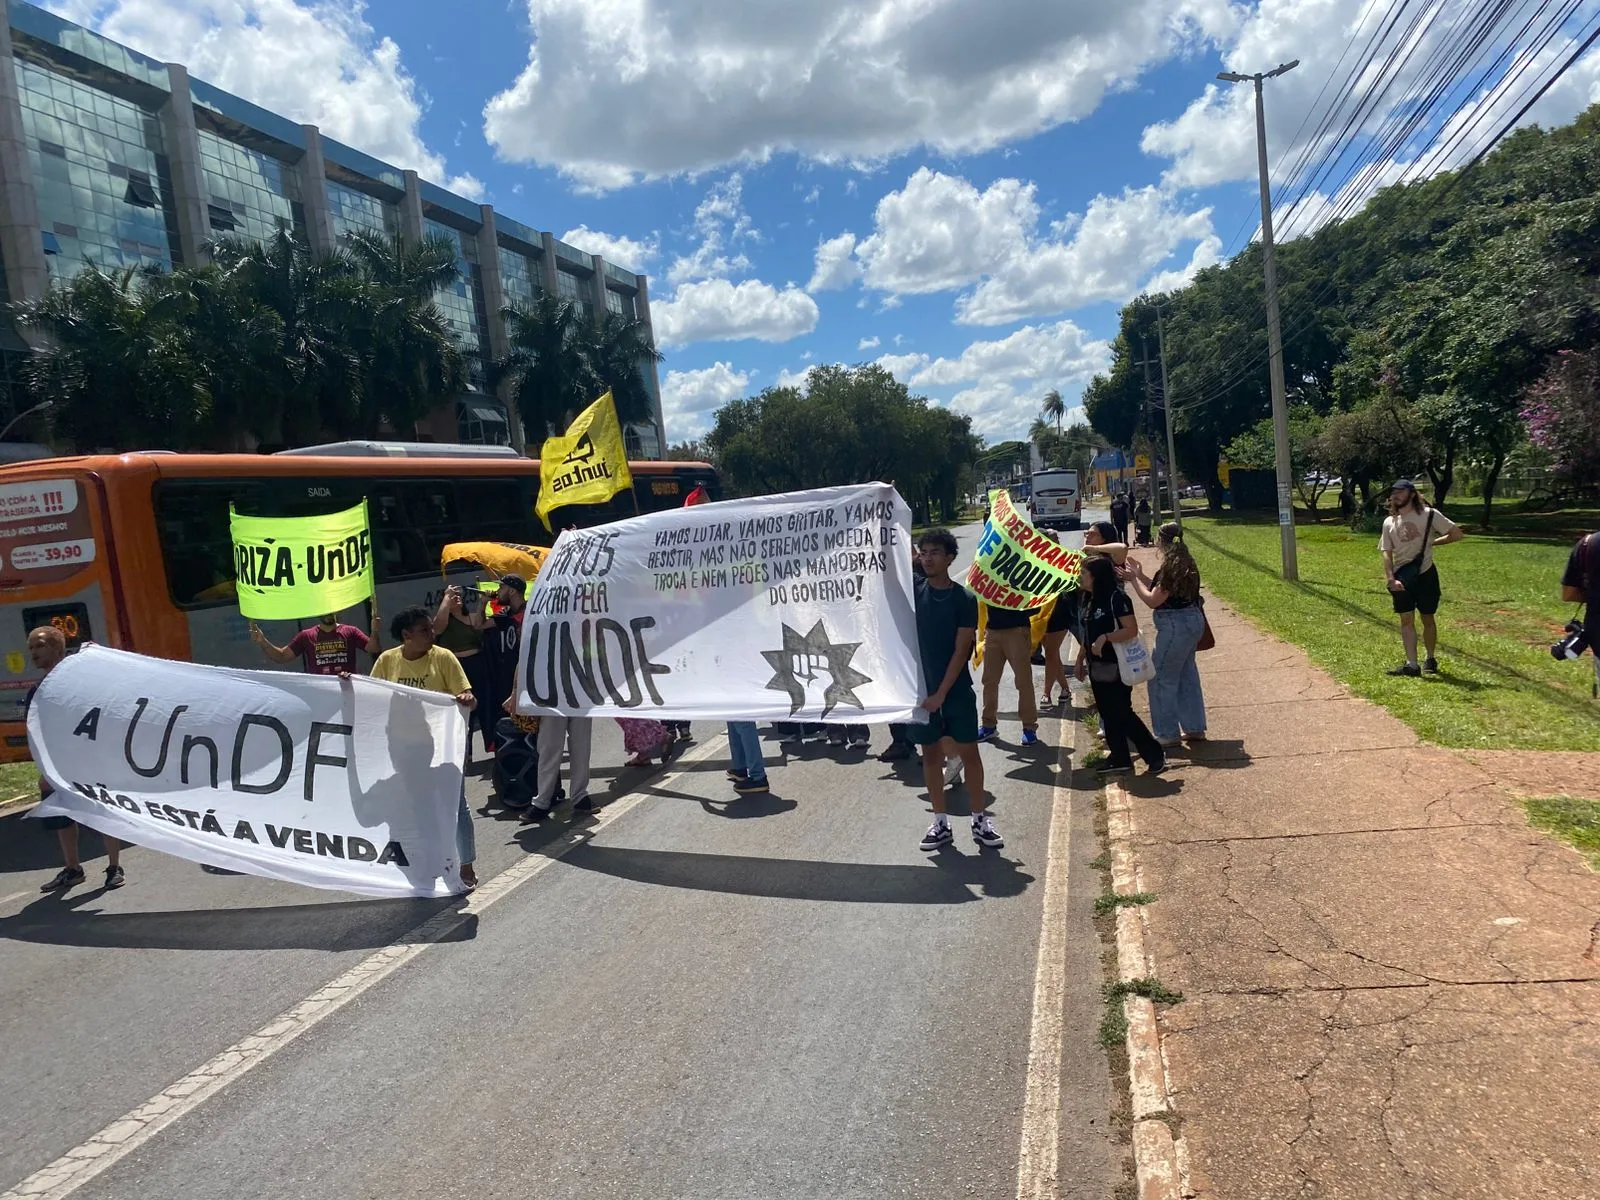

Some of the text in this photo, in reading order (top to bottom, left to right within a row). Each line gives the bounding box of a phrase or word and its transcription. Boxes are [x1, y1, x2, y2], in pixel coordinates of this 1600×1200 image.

[655, 500, 894, 547] VAMOS LUTAR, VAMOS GRITAR, VAMOS
[44, 545, 82, 561] 39,90
[647, 526, 898, 571] RESISTIR, MAS NÃO SEREMOS MOEDA DE
[654, 551, 887, 591] TROCA E NEM PEÕES NAS MANOBRAS
[990, 543, 1053, 596] DAQUI
[530, 581, 609, 615] LUTAR PELA
[769, 574, 865, 606] DO GOVERNO!
[500, 625, 517, 653] 10
[527, 616, 670, 707] UNDF
[73, 697, 353, 802] A UnDF
[73, 782, 410, 868] NÃO ESTÁ A VENDA
